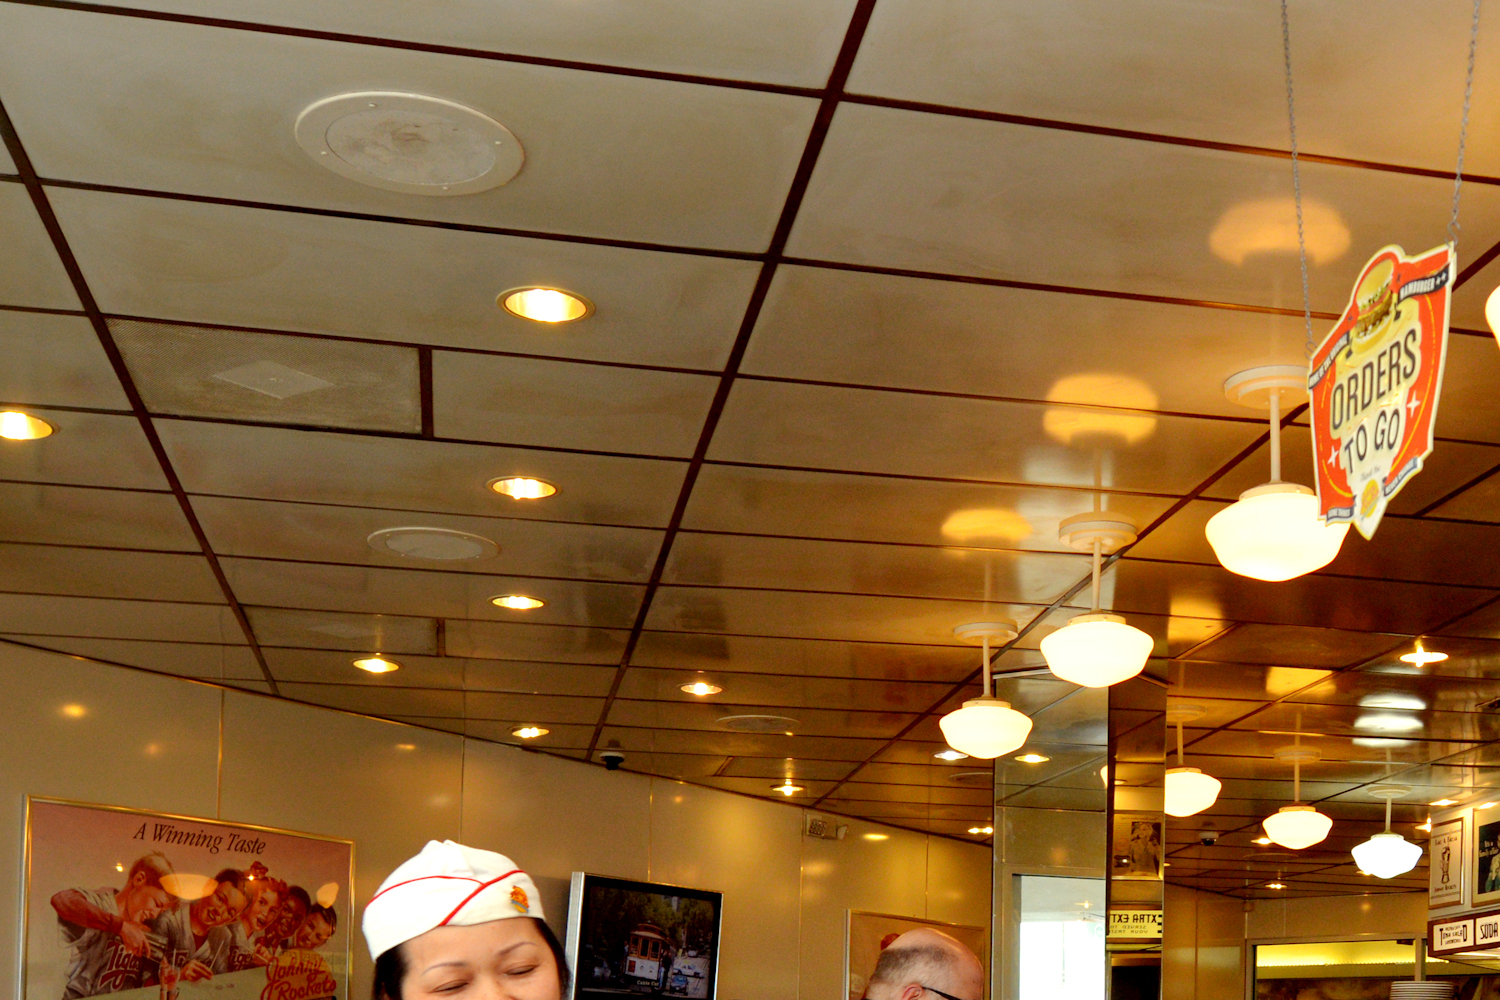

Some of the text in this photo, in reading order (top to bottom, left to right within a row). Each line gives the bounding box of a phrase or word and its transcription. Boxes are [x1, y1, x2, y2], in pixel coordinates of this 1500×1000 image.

[1331, 328, 1416, 430] ORDERS
[1345, 408, 1400, 474] TO GO
[133, 822, 266, 855] A Winning Taste
[1480, 922, 1498, 940] SODA
[265, 955, 327, 983] Johnny
